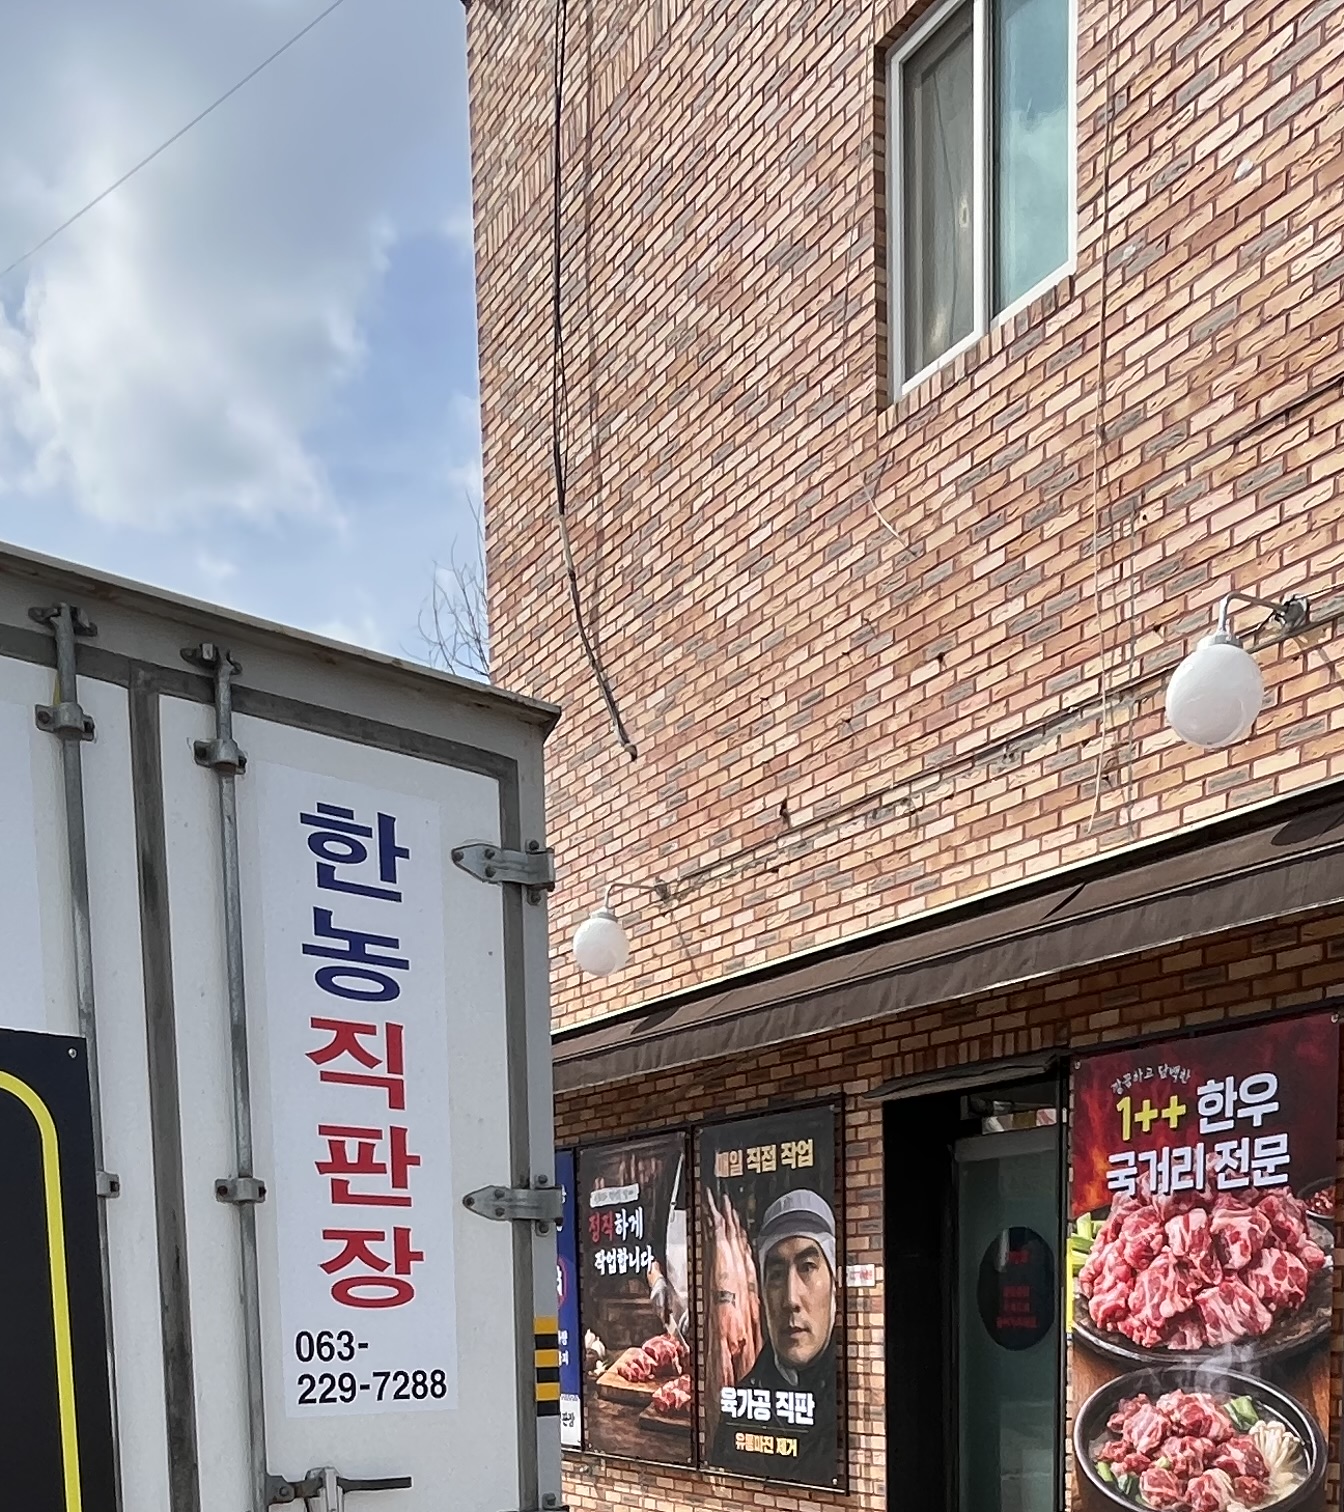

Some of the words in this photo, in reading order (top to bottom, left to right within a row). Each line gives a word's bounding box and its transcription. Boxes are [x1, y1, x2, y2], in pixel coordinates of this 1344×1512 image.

[1157, 1063, 1191, 1085] 담백한
[1116, 1095, 1187, 1141] 1++
[1196, 1072, 1279, 1134] 한우
[746, 1144, 777, 1174] 직접
[781, 1138, 814, 1169] 작업
[1106, 1142, 1205, 1196] 국거리
[1214, 1133, 1290, 1190] 전문
[588, 1206, 645, 1243] 정직하게
[594, 1245, 655, 1276] 작업합니다
[295, 1330, 368, 1362] 063-
[297, 1369, 447, 1404] 229-7288
[720, 1386, 771, 1421] 육가공
[775, 1390, 815, 1425] 직판
